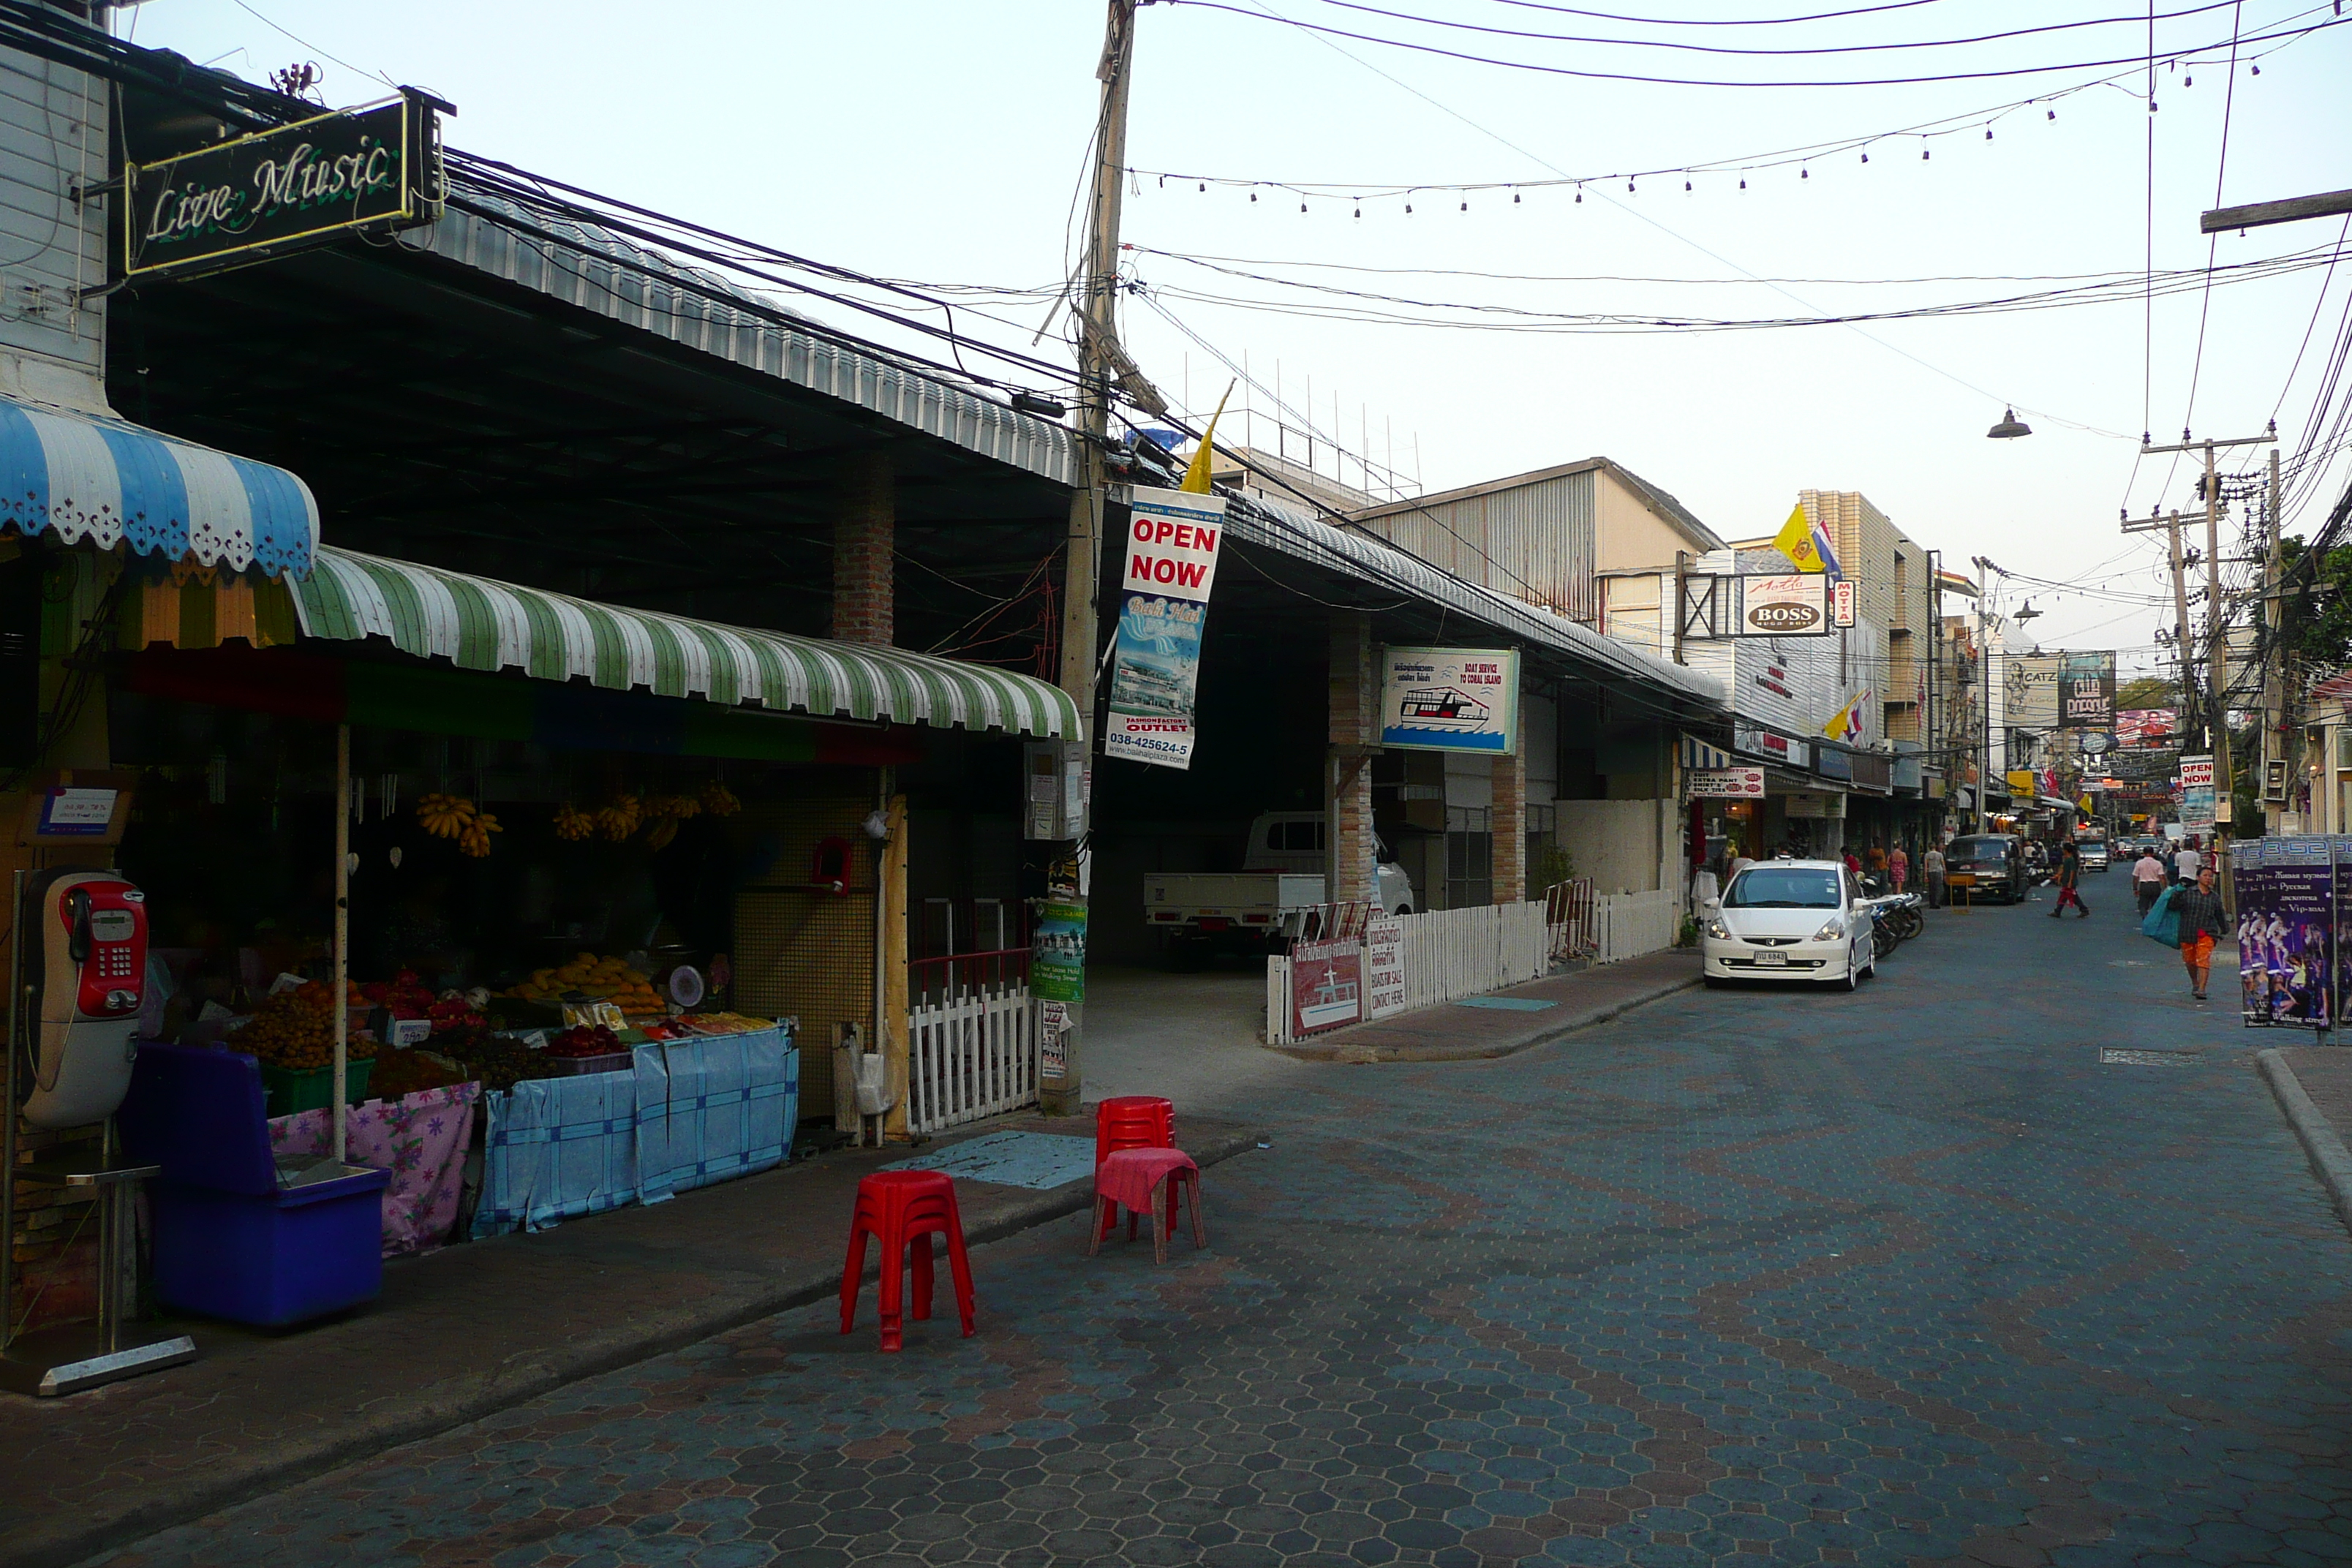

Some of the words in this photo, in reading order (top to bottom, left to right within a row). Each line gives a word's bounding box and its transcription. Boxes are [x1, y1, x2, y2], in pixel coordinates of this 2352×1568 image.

[146, 181, 233, 240] Live
[253, 135, 388, 213] Music
[1134, 519, 1216, 553] OPEN
[1131, 554, 1207, 589] NOW
[1129, 597, 1167, 617] Bali
[1166, 603, 1203, 623] Hai
[1838, 583, 1851, 619] MOTTA
[1757, 608, 1812, 621] BOSS
[1465, 663, 1478, 673] BOAT
[1479, 663, 1497, 673] SERVICE
[2024, 672, 2057, 682] CATZ
[1460, 674, 1466, 684] TO
[1467, 674, 1482, 684] CORAL
[1484, 674, 1501, 685] ISLAND
[1110, 733, 1188, 755] 038-425624-5
[1109, 745, 1185, 764] www.balihaiplaza.com
[2182, 764, 2212, 772] OPEN
[2185, 774, 2211, 783] NOW
[2263, 841, 2328, 855] B-52
[1371, 973, 1384, 989] BOATS
[1392, 969, 1402, 984] SALE
[1372, 992, 1390, 1010] CONTACT
[1391, 989, 1403, 1006] HERE
[2272, 1013, 2302, 1022] Walking
